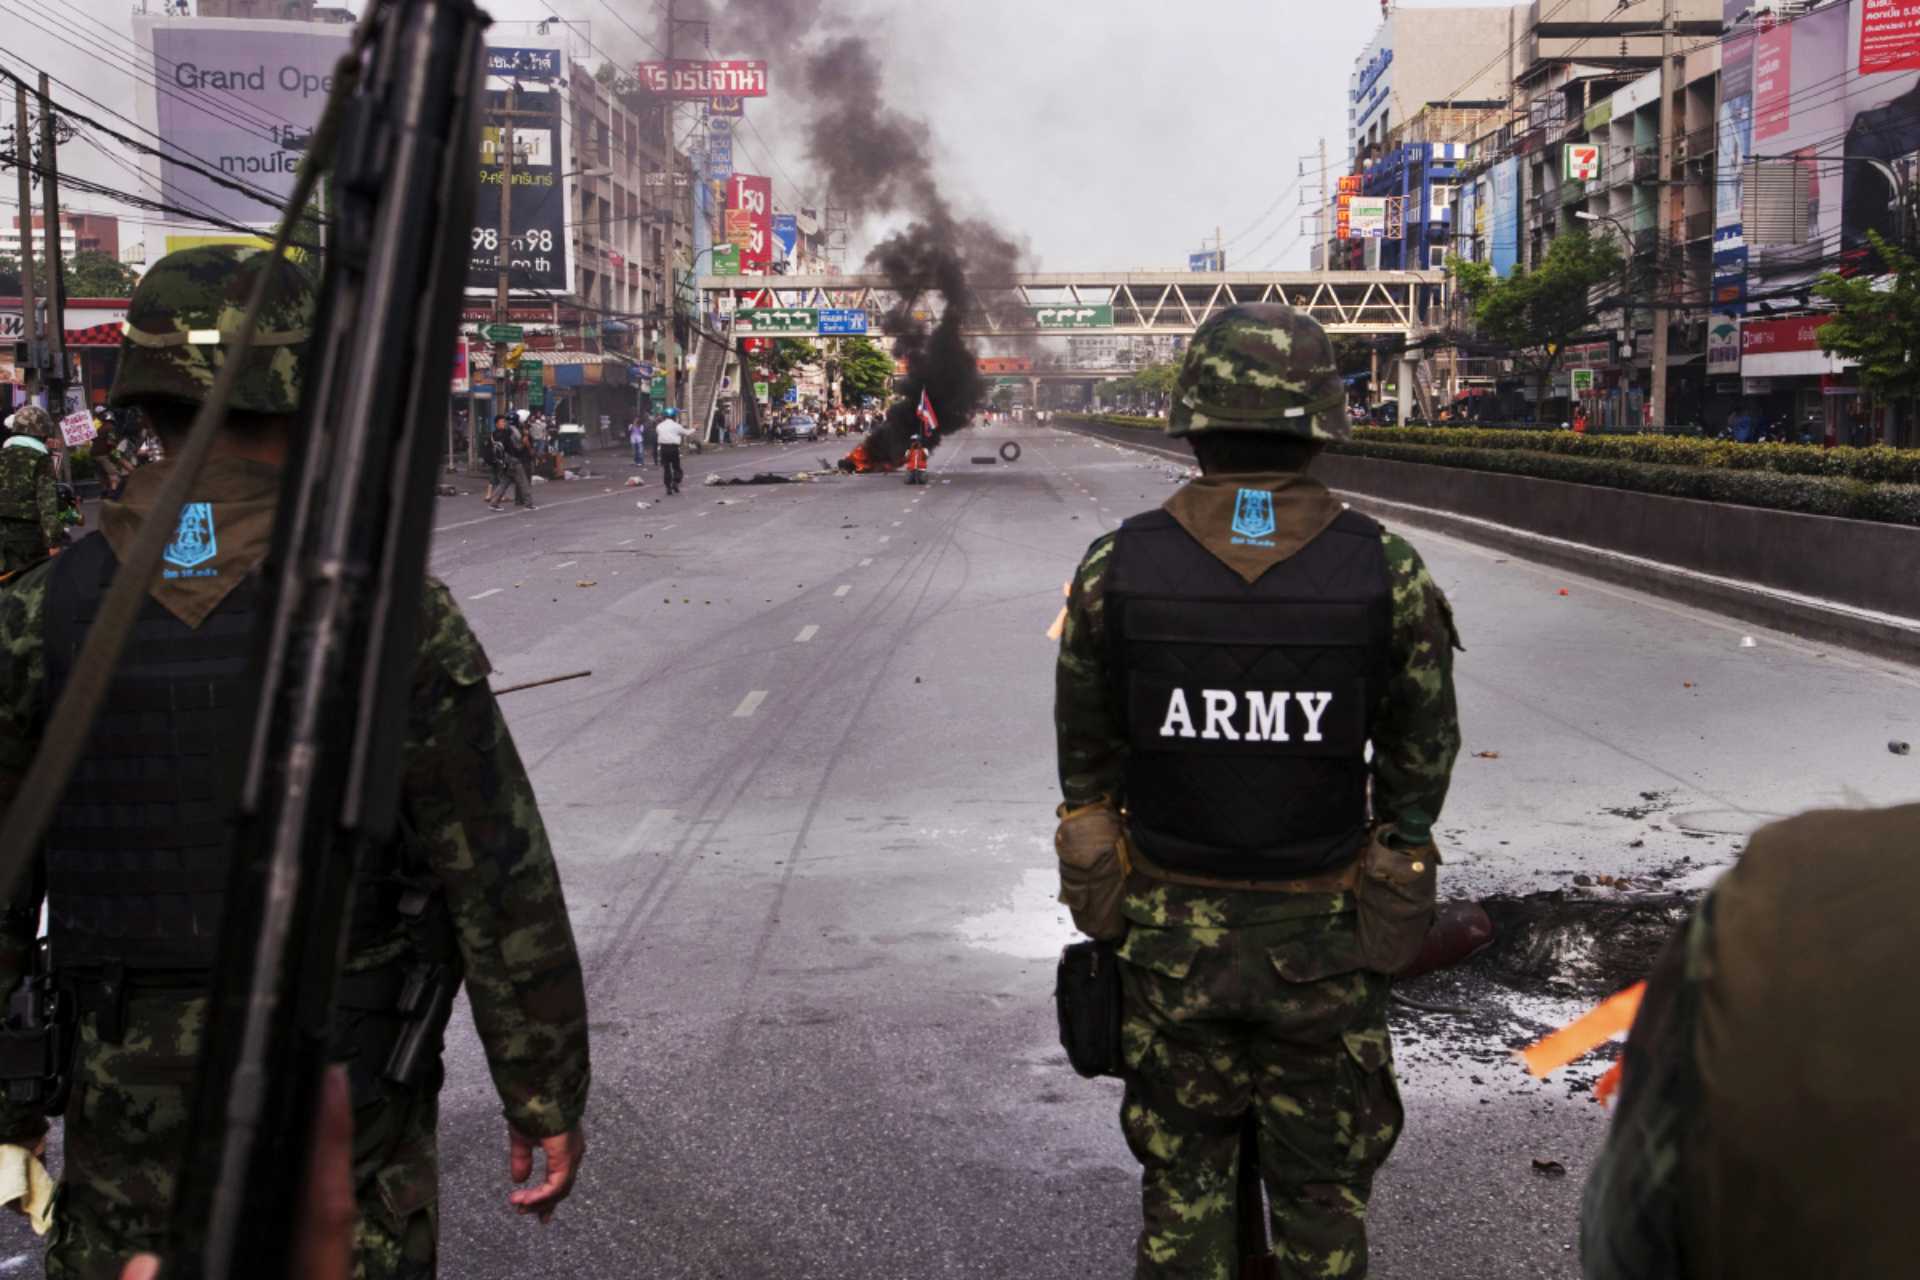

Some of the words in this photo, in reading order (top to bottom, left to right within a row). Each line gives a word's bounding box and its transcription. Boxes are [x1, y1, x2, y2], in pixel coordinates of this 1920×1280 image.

[175, 62, 264, 91] Grand
[643, 62, 765, 91] โรงรับจำนำ
[1160, 687, 1333, 742] ARMY
